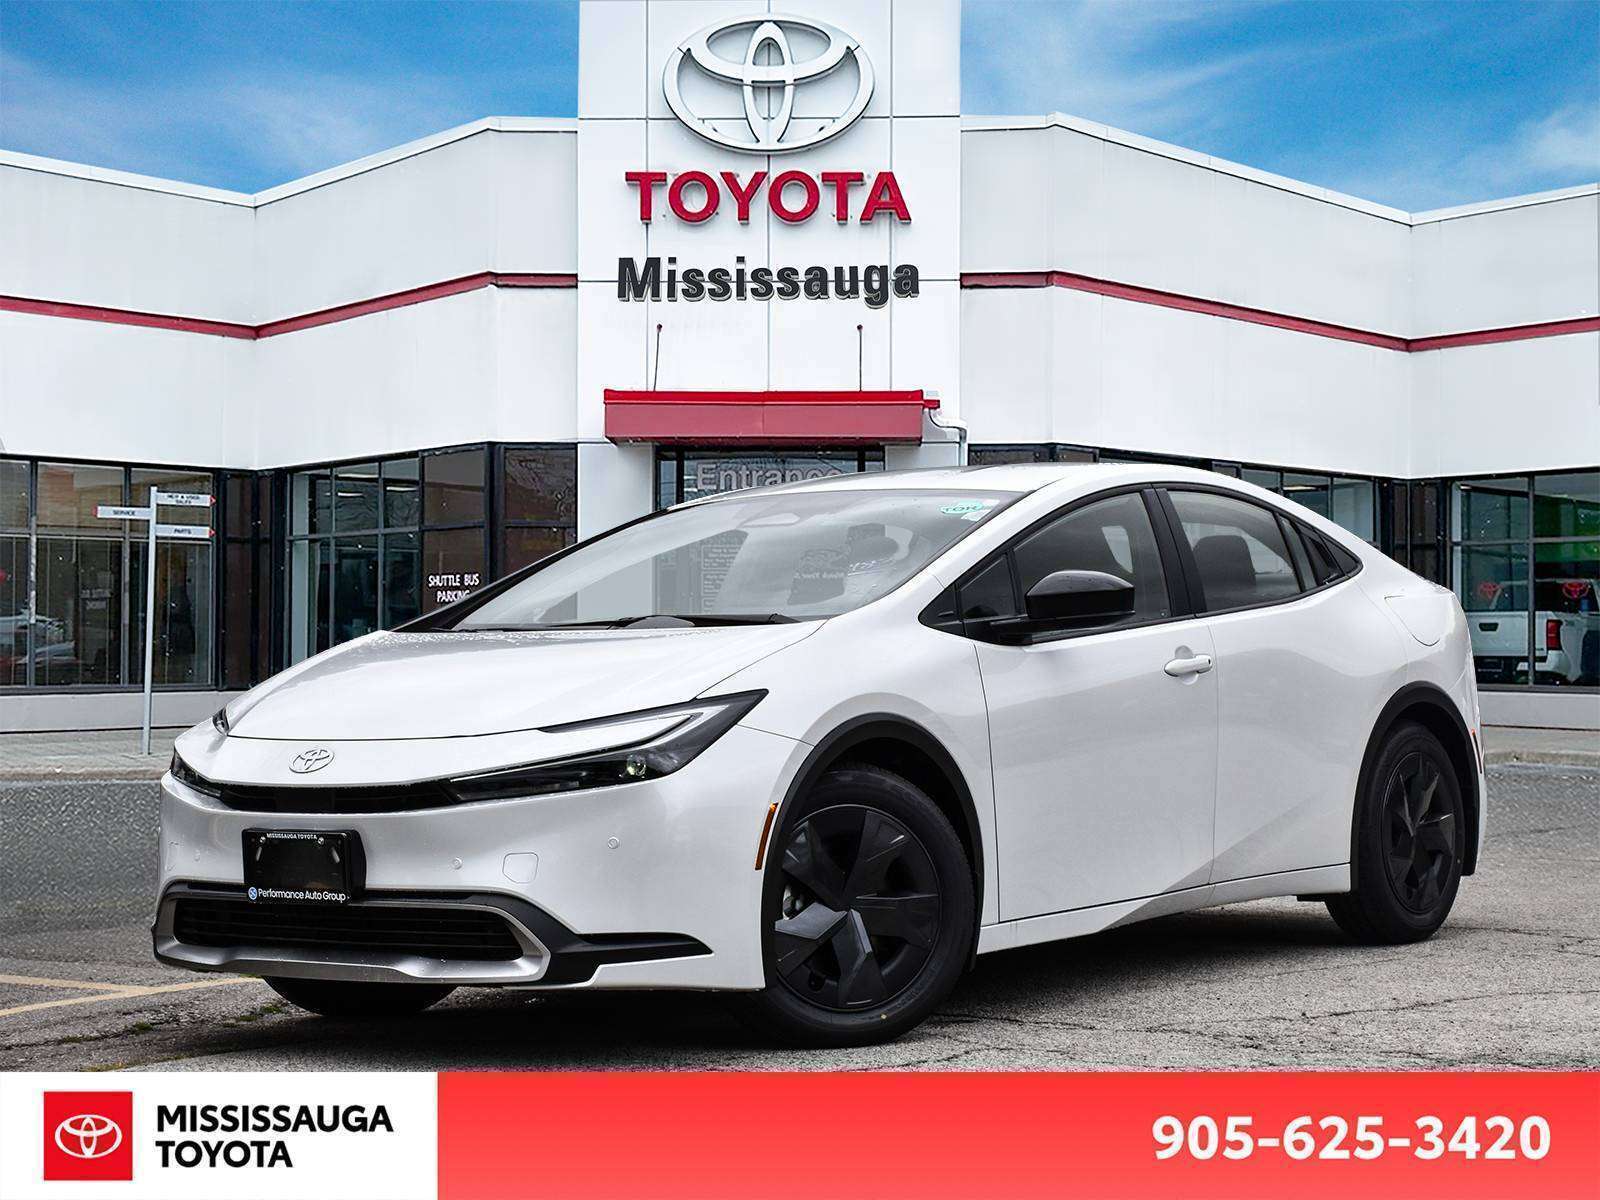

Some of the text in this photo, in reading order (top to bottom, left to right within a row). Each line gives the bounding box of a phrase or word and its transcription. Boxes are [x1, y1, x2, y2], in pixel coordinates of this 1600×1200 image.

[625, 171, 912, 225] TOYOTA
[617, 256, 919, 309] Mississauga
[428, 573, 479, 587] SHUTTLE BUS
[258, 888, 346, 903] Performance Auto Group
